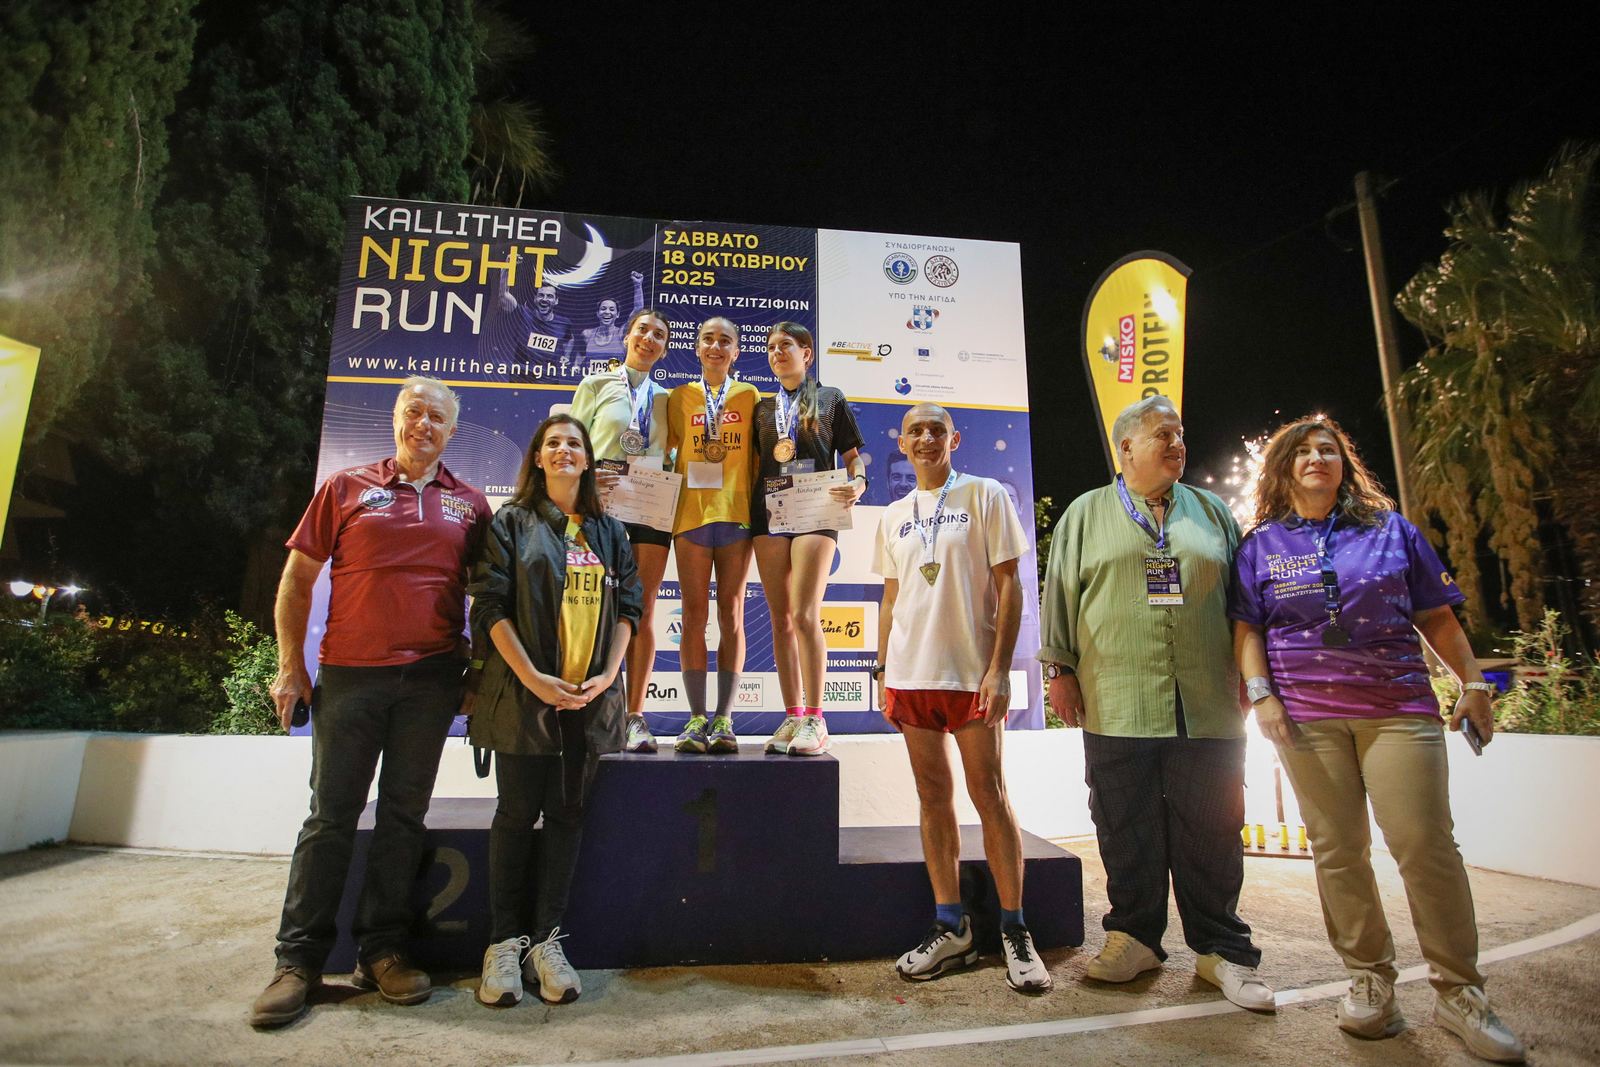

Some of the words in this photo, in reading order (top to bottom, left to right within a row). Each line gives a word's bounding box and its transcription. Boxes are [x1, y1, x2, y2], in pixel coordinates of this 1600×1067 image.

[364, 206, 562, 242] KALLITHEA
[663, 231, 759, 249] ΣΑΒΒΑΤΟ
[885, 241, 955, 252] ΣΥΝΔΙΟΡΓΑΝΩΣΗ
[358, 236, 558, 288] NIGHT
[663, 250, 685, 265] 18
[691, 252, 808, 271] ΟΚΤΩΒΡΙΟΥ
[661, 270, 716, 286] 2025
[659, 293, 723, 306] ΠΛΑΤΕΙΑ
[727, 296, 809, 311] ΤΖΙΤΖΙΦΙΩΝ
[888, 292, 906, 300] ΥΠΟ
[909, 293, 926, 301] ΤΗΝ
[928, 295, 956, 303] ΑΙΓΙΔΑ
[352, 287, 483, 334] RUN
[668, 321, 695, 330] ΩΝΑΣ
[670, 331, 695, 339] ΩΝΑΣ
[741, 335, 767, 343] 5.000
[531, 335, 556, 351] 1162
[668, 342, 694, 350] ΩΝΑΣ
[741, 345, 767, 353] 2.500
[1119, 317, 1135, 380] MISKO
[348, 356, 600, 379] www.kallitheanightru
[668, 371, 702, 380] kallithean
[693, 412, 740, 425] MKO
[693, 432, 741, 447] PREIN
[485, 485, 515, 493] ΕΠΙΣΗ
[566, 552, 600, 564] SKO
[1270, 559, 1317, 575] NIGHT
[822, 692, 862, 701] EWS.GR
[426, 846, 471, 931] 2
